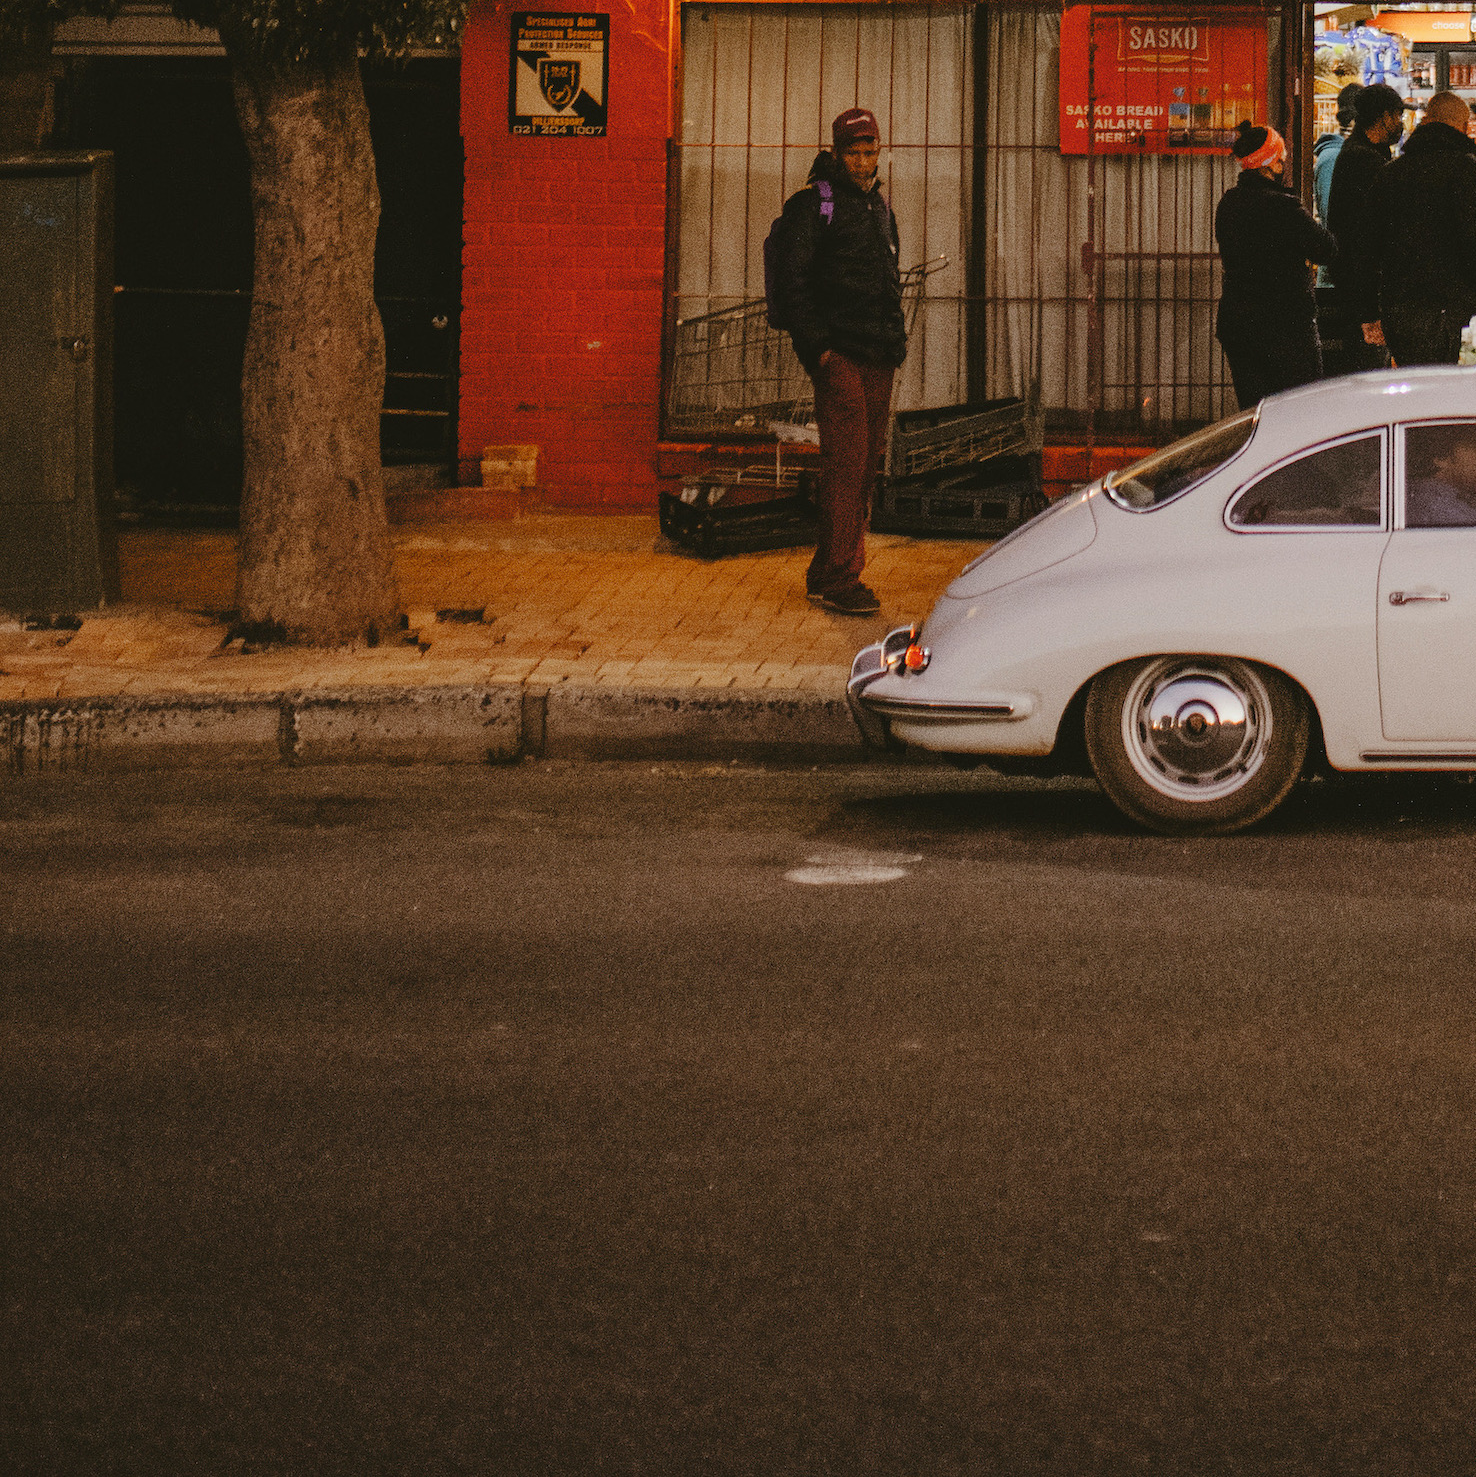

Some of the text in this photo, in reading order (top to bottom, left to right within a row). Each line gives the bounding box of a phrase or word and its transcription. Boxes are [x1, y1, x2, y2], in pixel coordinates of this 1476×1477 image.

[1432, 20, 1465, 30] choose
[1129, 26, 1198, 50] SASKO
[1116, 105, 1164, 116] BREAD
[513, 125, 603, 135] 021 204 1007
